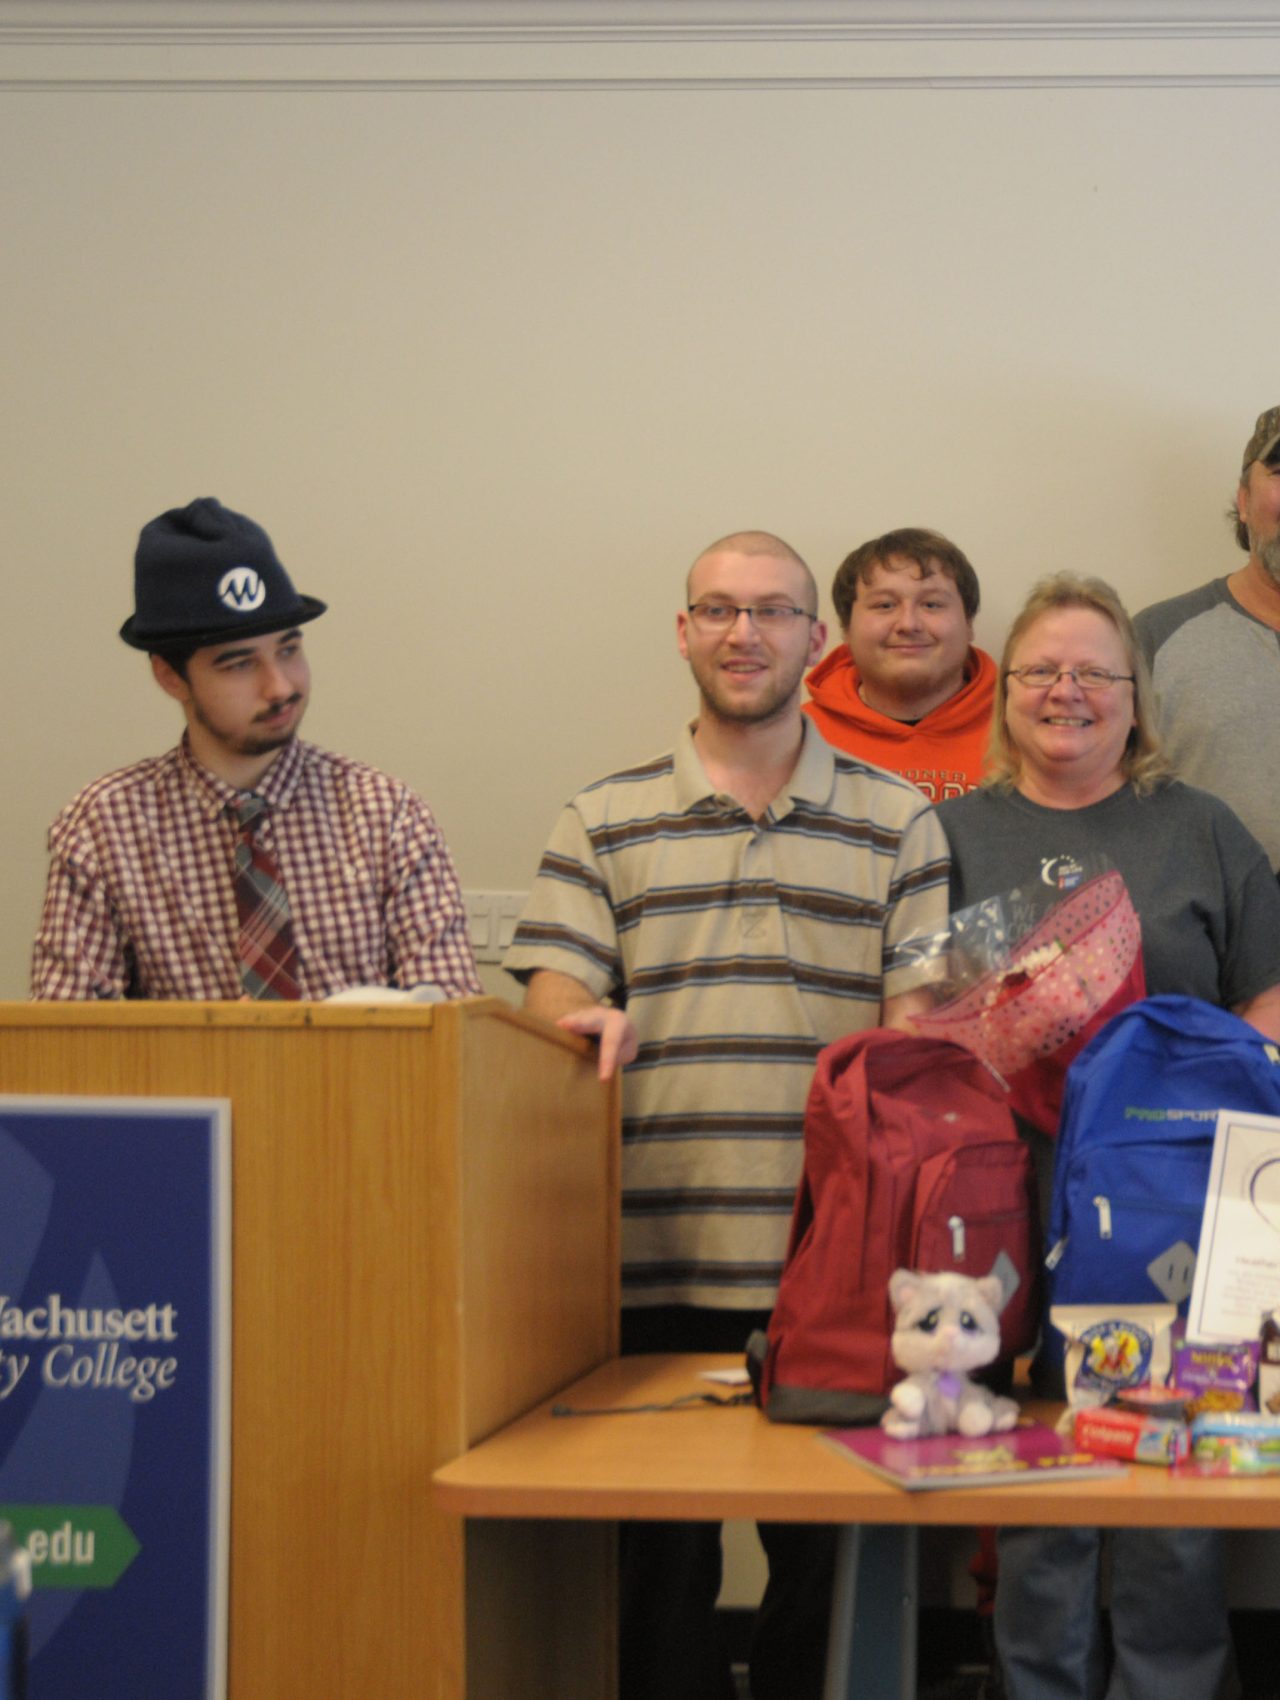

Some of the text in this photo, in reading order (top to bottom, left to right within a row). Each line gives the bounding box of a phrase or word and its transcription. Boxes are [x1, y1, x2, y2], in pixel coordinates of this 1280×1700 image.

[220, 571, 261, 608] W
[0, 1293, 178, 1341] achusett
[43, 1341, 178, 1402] College
